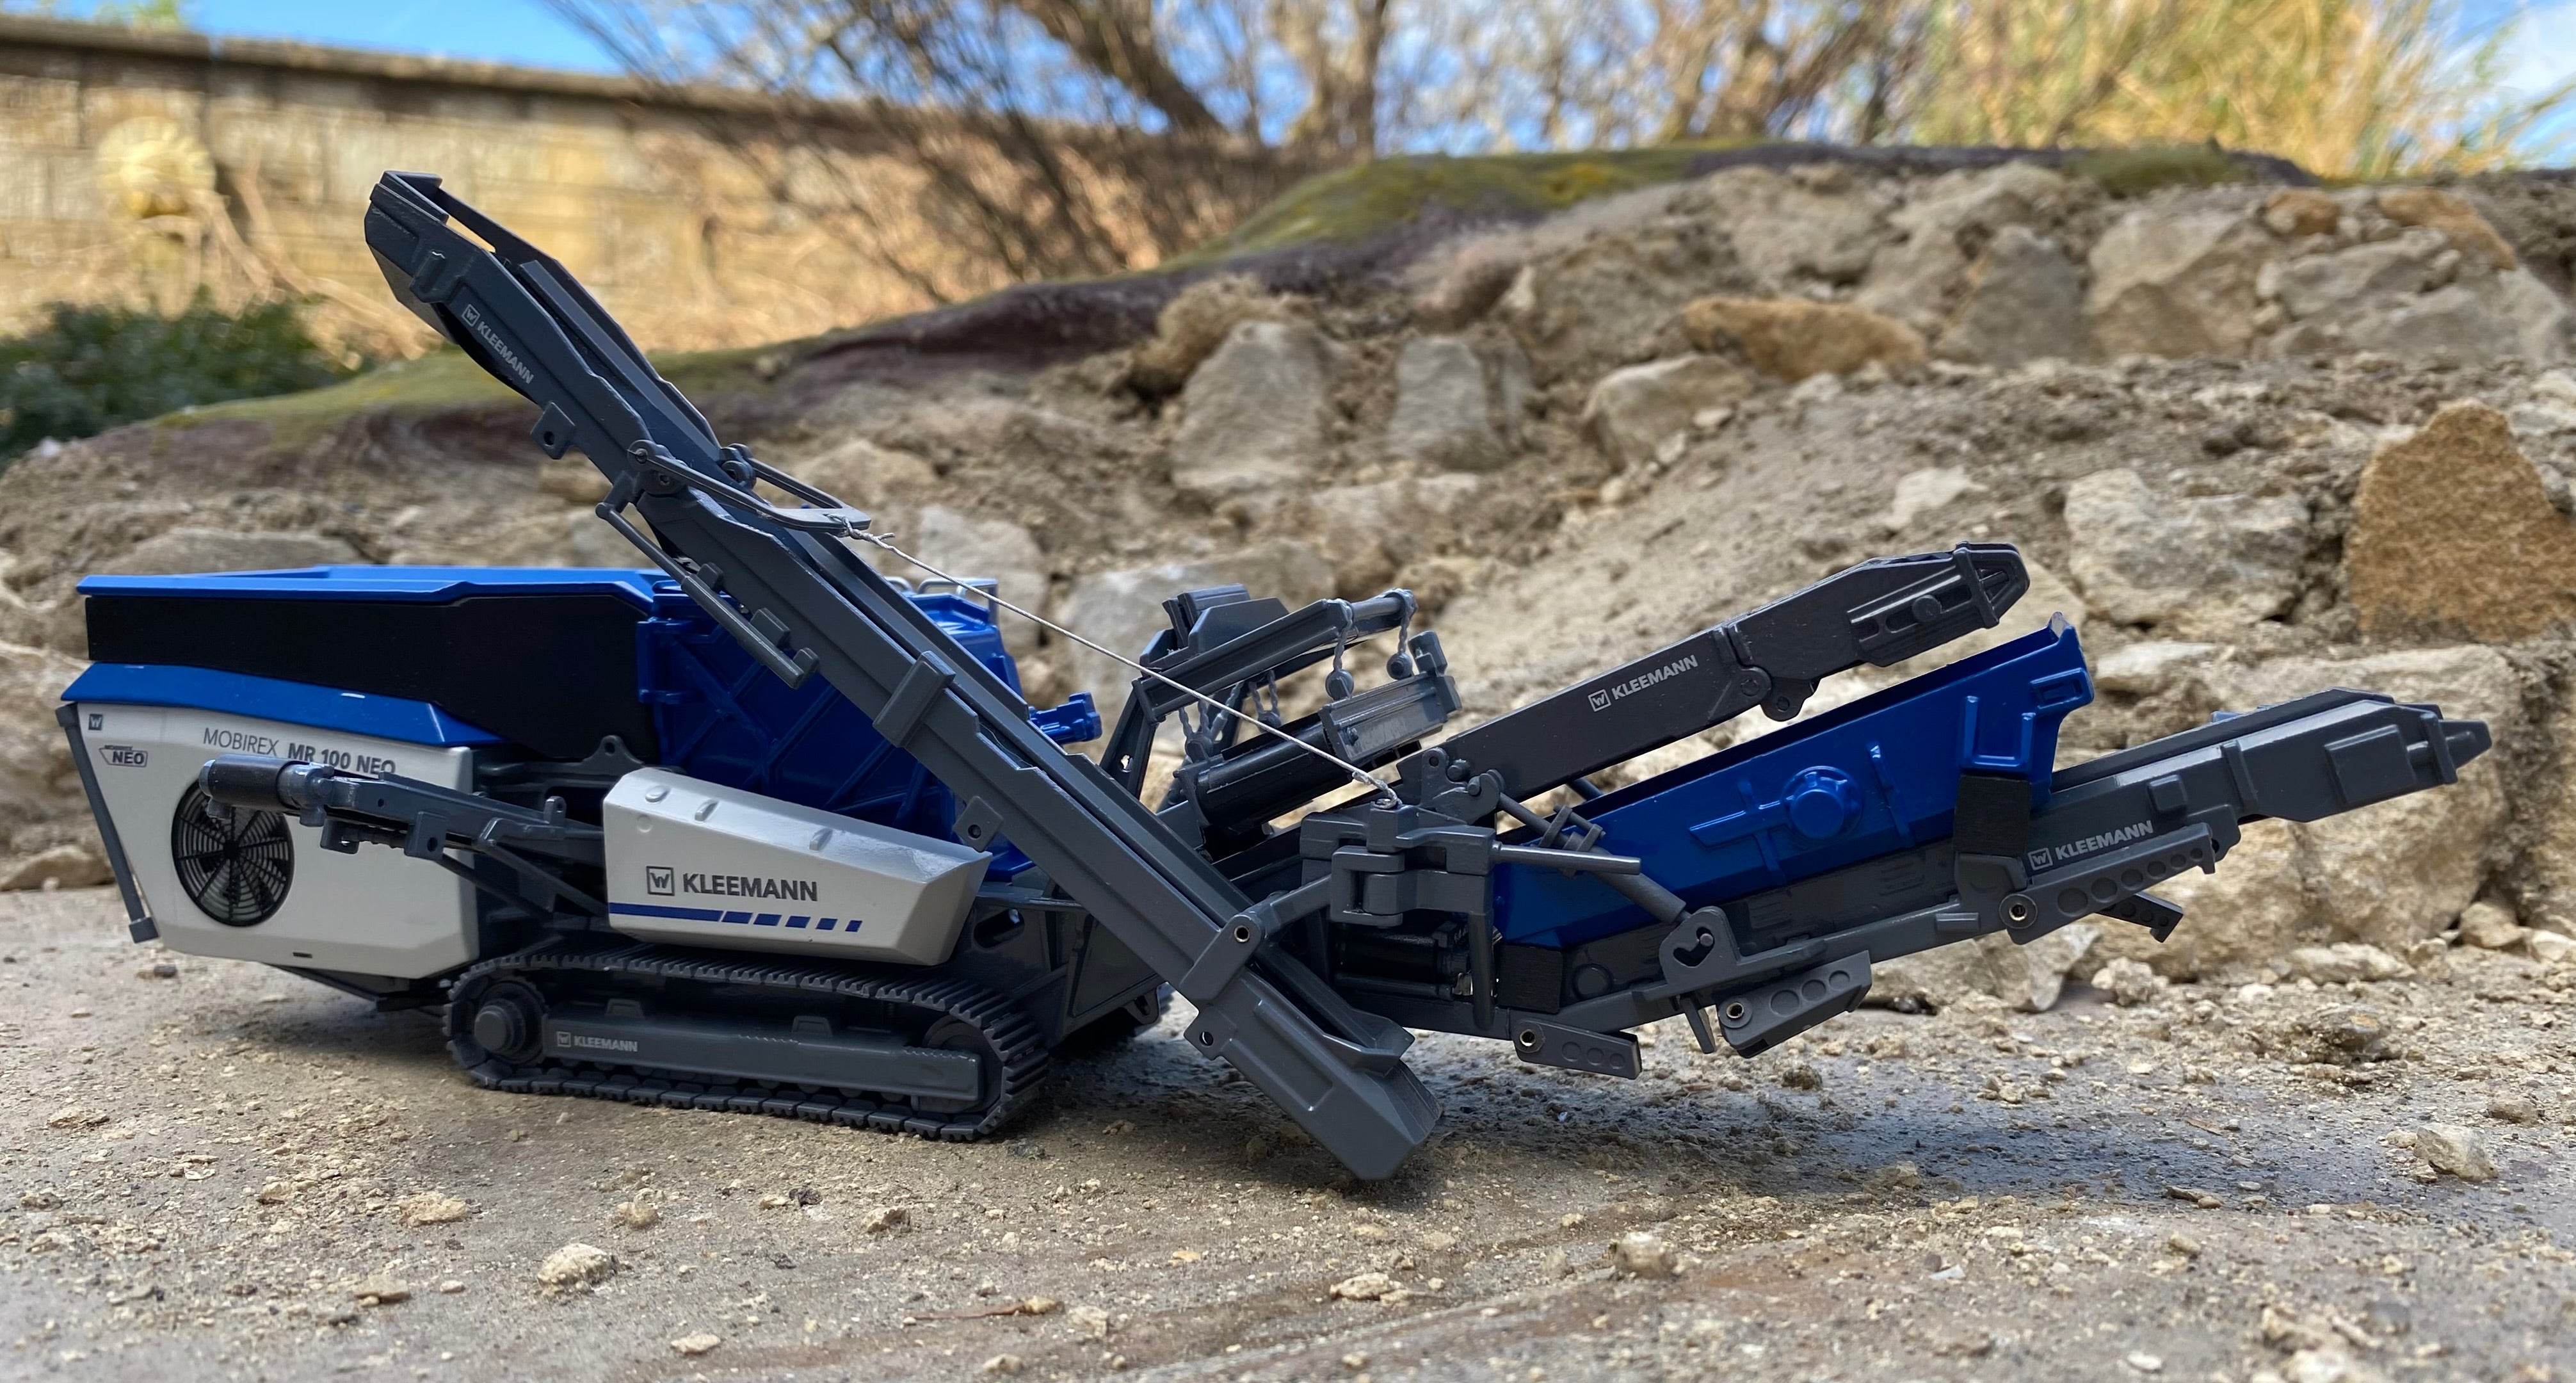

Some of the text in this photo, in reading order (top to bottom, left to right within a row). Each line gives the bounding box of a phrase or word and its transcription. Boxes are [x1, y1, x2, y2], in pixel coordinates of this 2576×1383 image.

[478, 321, 534, 384] KLEEMANN
[1611, 654, 1698, 700] KLEEMANN
[112, 751, 145, 764] NEO
[203, 727, 396, 774] MOBIREX MR 100 NEO
[2055, 820, 2154, 861] KLEEMANN
[682, 873, 818, 902] KLEEMANN
[574, 1035, 638, 1052] KLEEMANN
